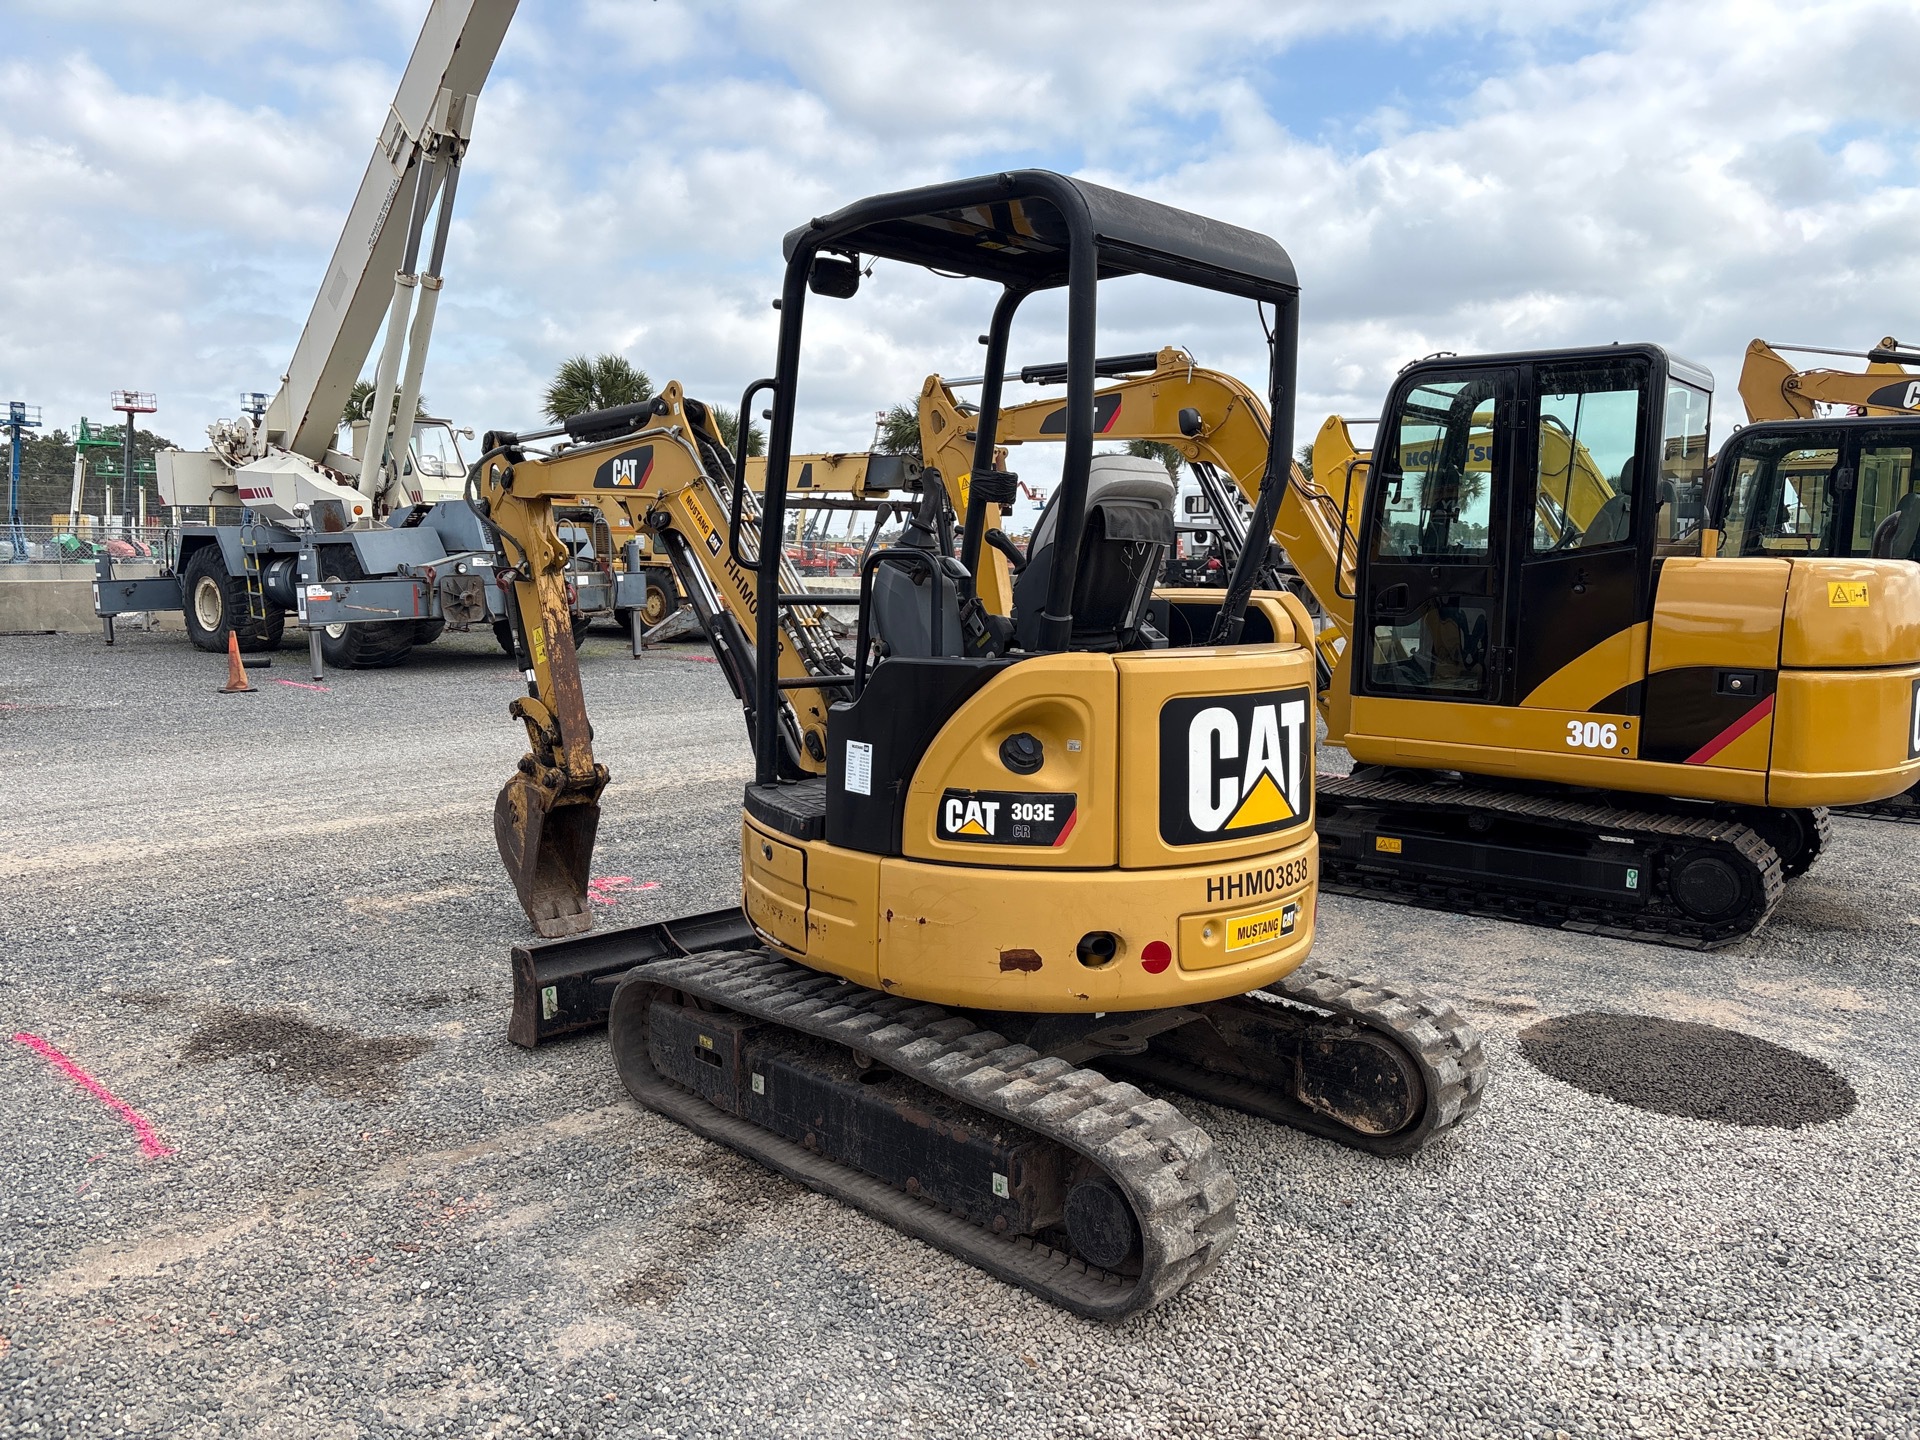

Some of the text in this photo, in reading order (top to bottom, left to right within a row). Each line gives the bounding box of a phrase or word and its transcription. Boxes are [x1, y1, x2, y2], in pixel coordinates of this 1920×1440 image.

[612, 458, 638, 486] CAT
[685, 495, 721, 552] MUSTANG CAT
[1565, 720, 1618, 750] 306
[1188, 699, 1306, 833] CAT
[945, 798, 1055, 836] CAT 303E
[1012, 824, 1031, 838] CR
[1206, 856, 1308, 903] HHM03838
[1236, 908, 1296, 942] MUSTANG CAT
